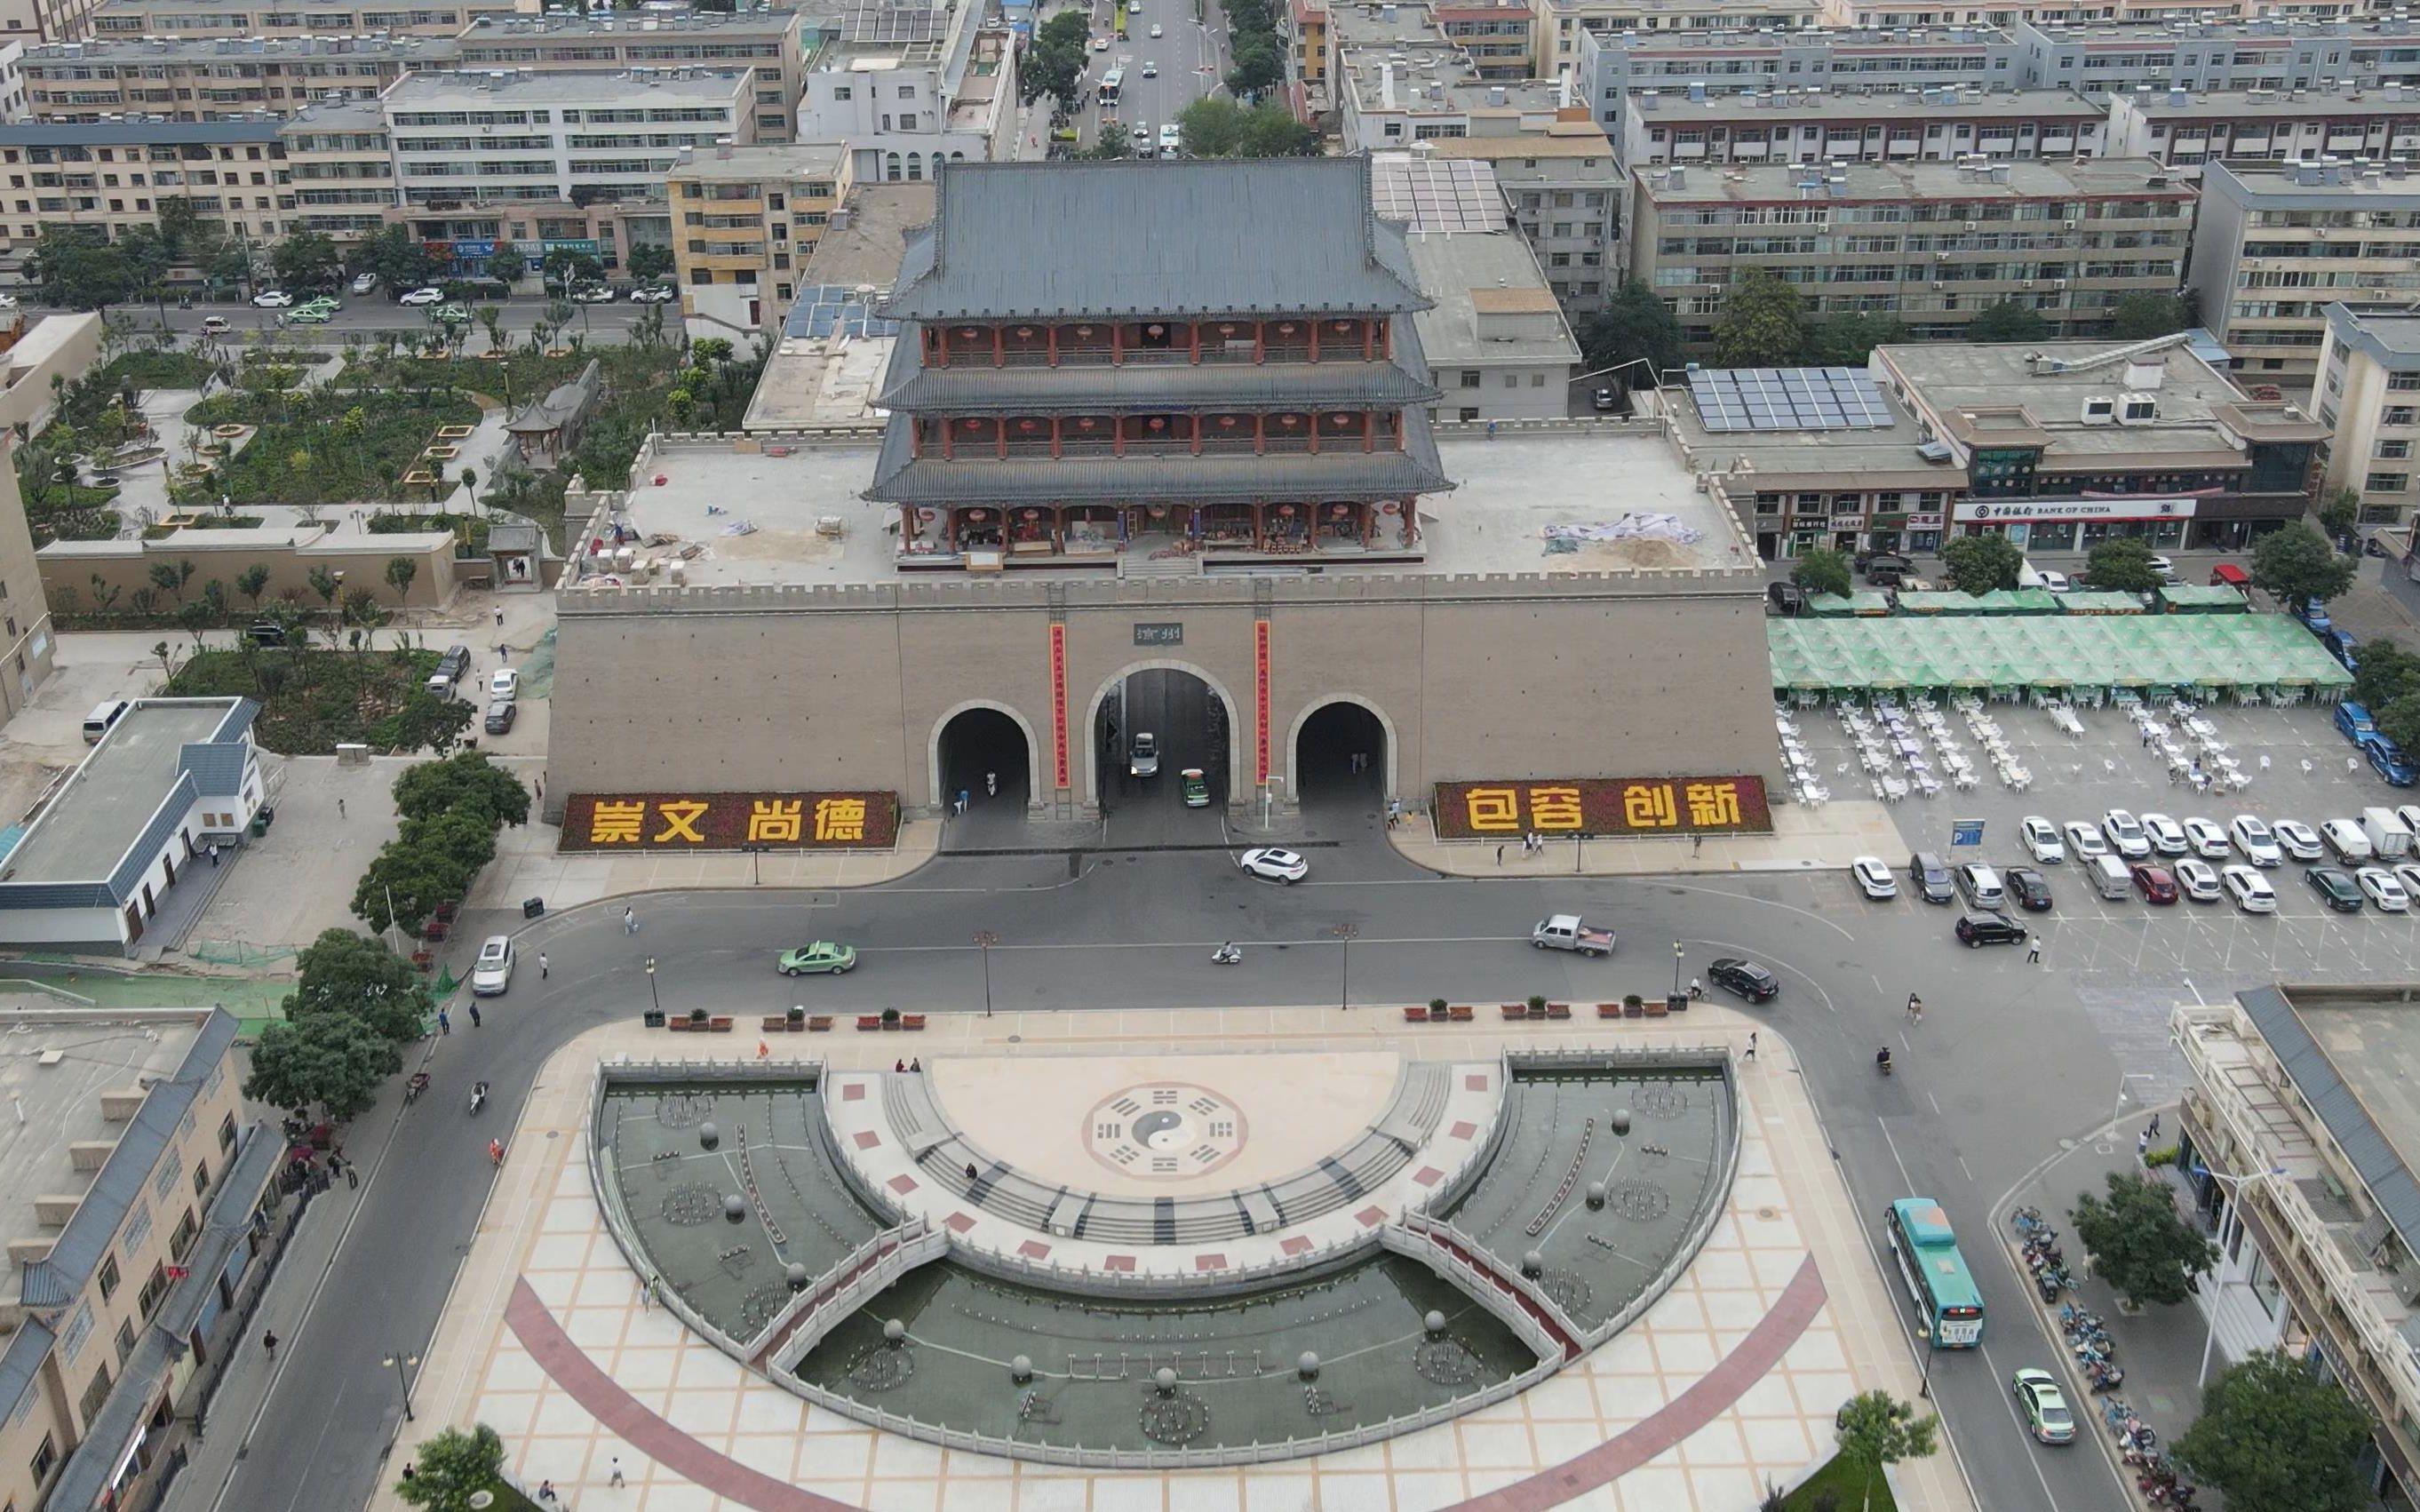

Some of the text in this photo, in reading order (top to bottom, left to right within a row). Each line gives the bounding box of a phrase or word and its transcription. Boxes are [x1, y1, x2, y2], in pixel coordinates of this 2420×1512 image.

[591, 799, 867, 843] 崇文 尚德
[1466, 783, 1741, 831] 包容 创新
[1954, 832, 1962, 844] P
